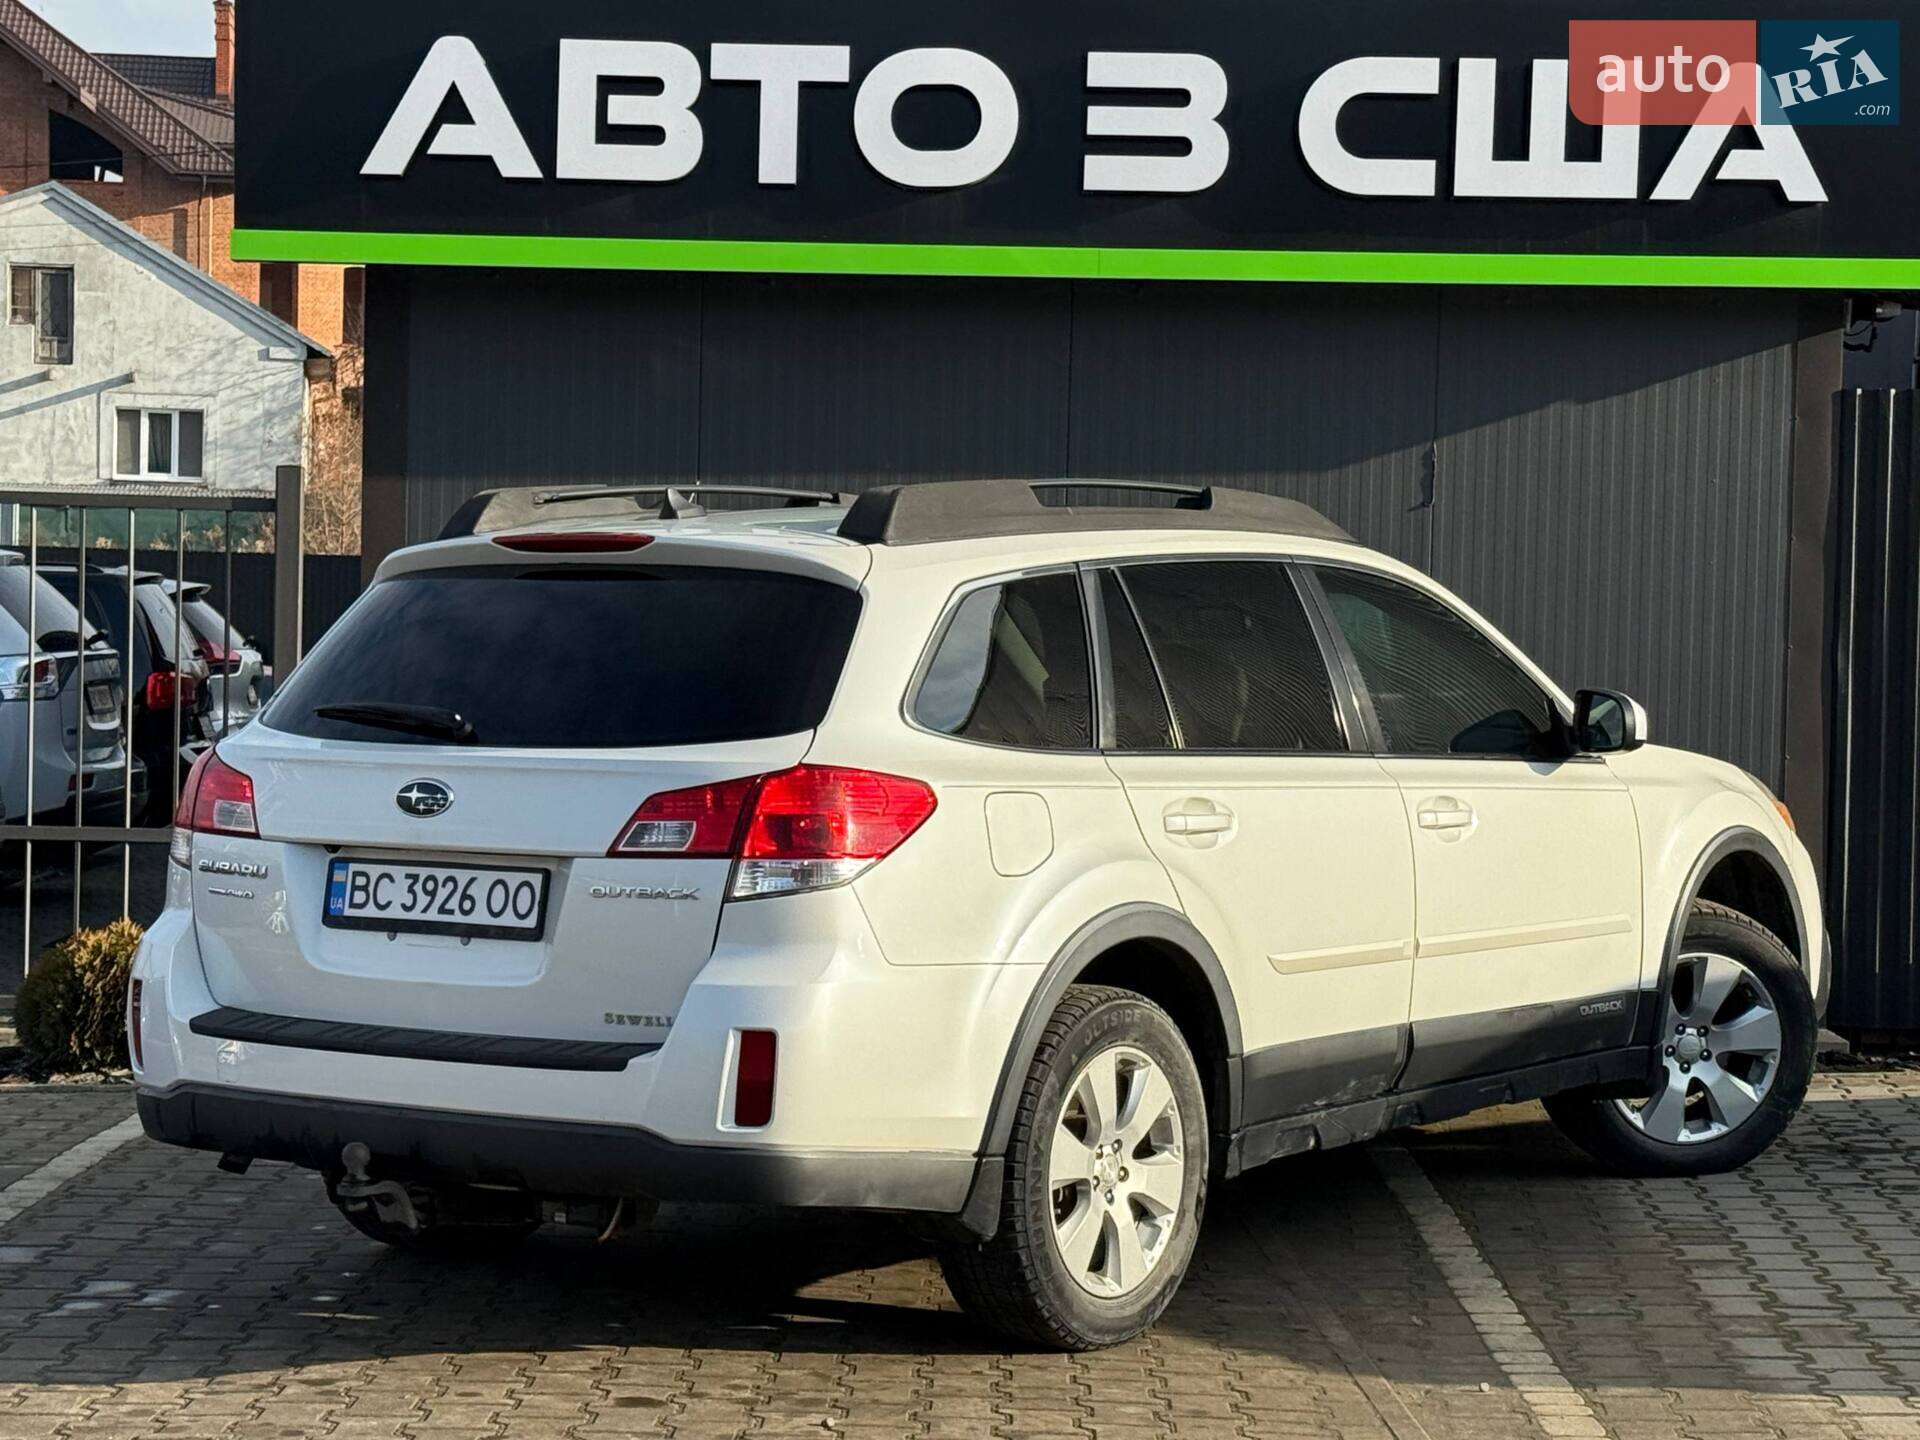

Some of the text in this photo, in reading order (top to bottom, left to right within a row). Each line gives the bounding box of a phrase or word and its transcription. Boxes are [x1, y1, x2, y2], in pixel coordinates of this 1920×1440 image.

[359, 35, 1020, 188] АВТО
[1298, 56, 1829, 202] США
[198, 859, 269, 880] SUBARU
[590, 885, 701, 901] OUTBACK
[329, 897, 344, 910] UA
[1579, 1000, 1622, 1016] OUTBACK
